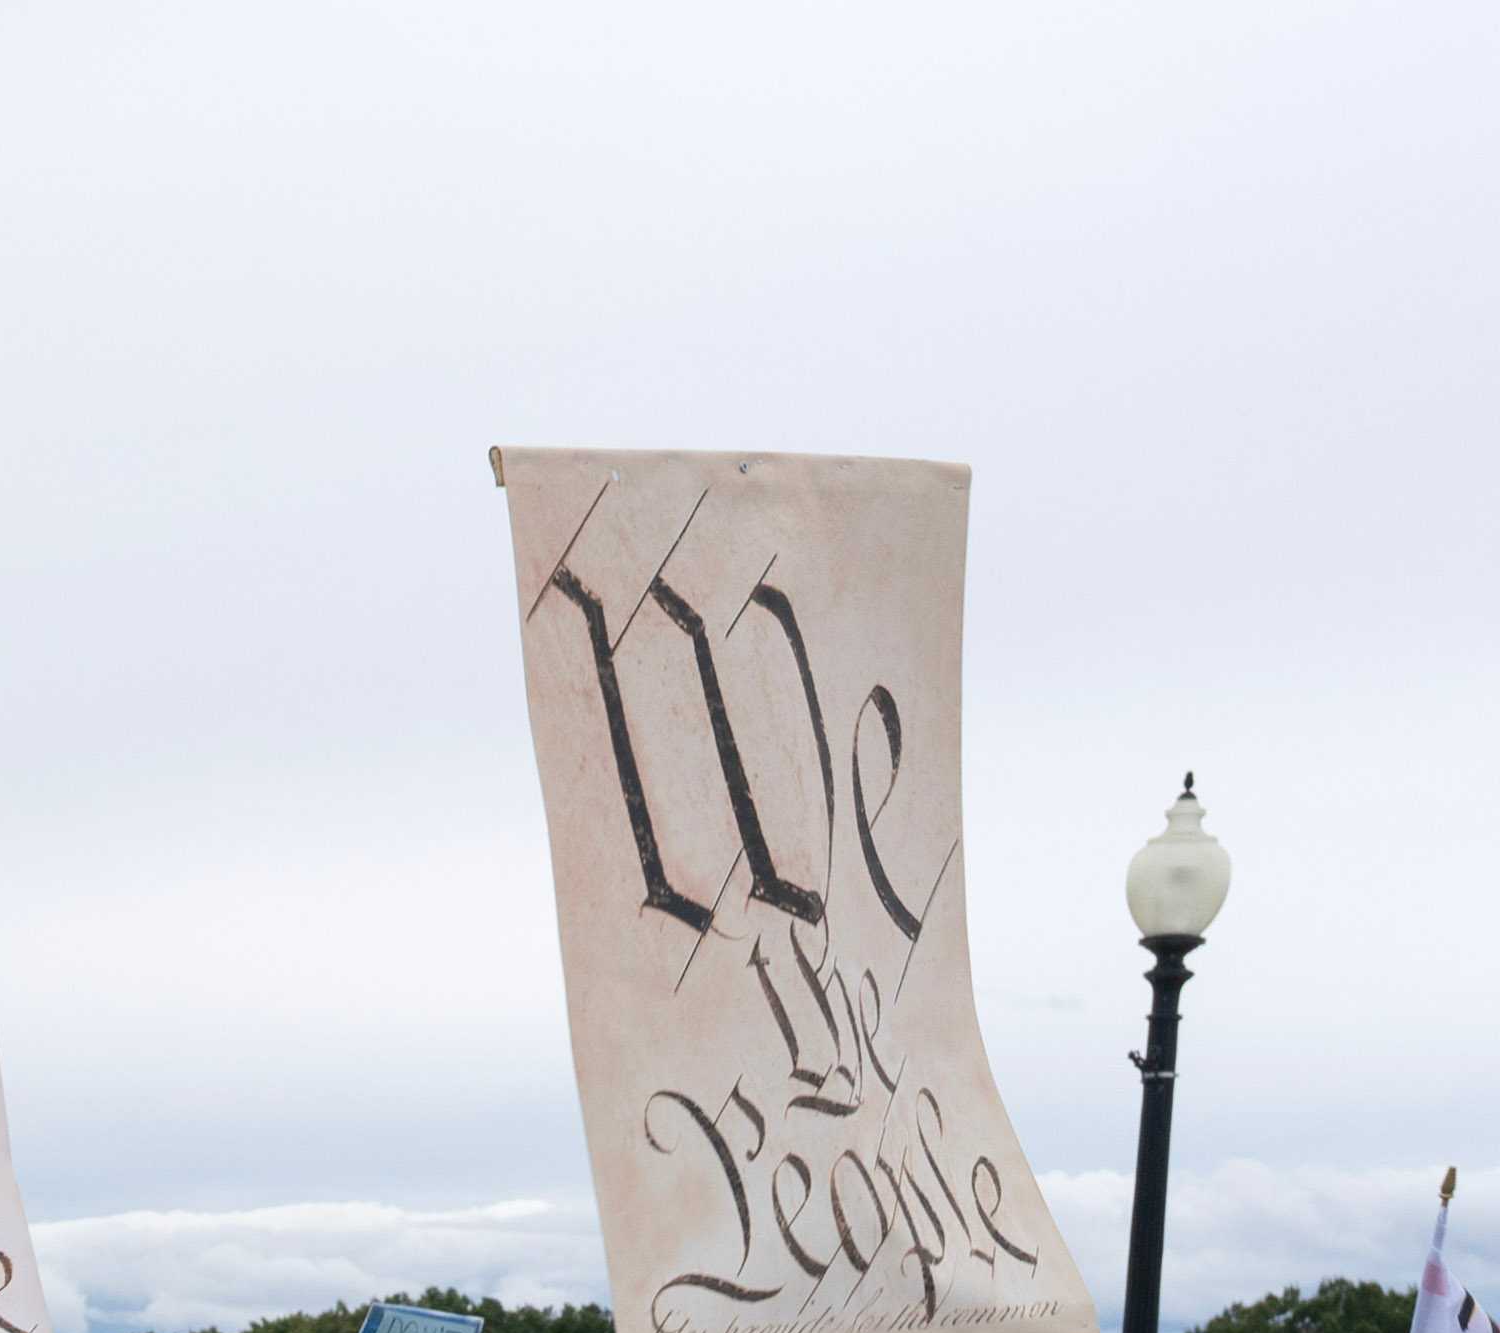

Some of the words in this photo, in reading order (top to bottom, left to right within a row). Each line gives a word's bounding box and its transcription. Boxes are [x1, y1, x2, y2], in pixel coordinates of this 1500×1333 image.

[527, 480, 958, 1004] We
[745, 922, 905, 1115] the
[644, 1059, 1037, 1322] People
